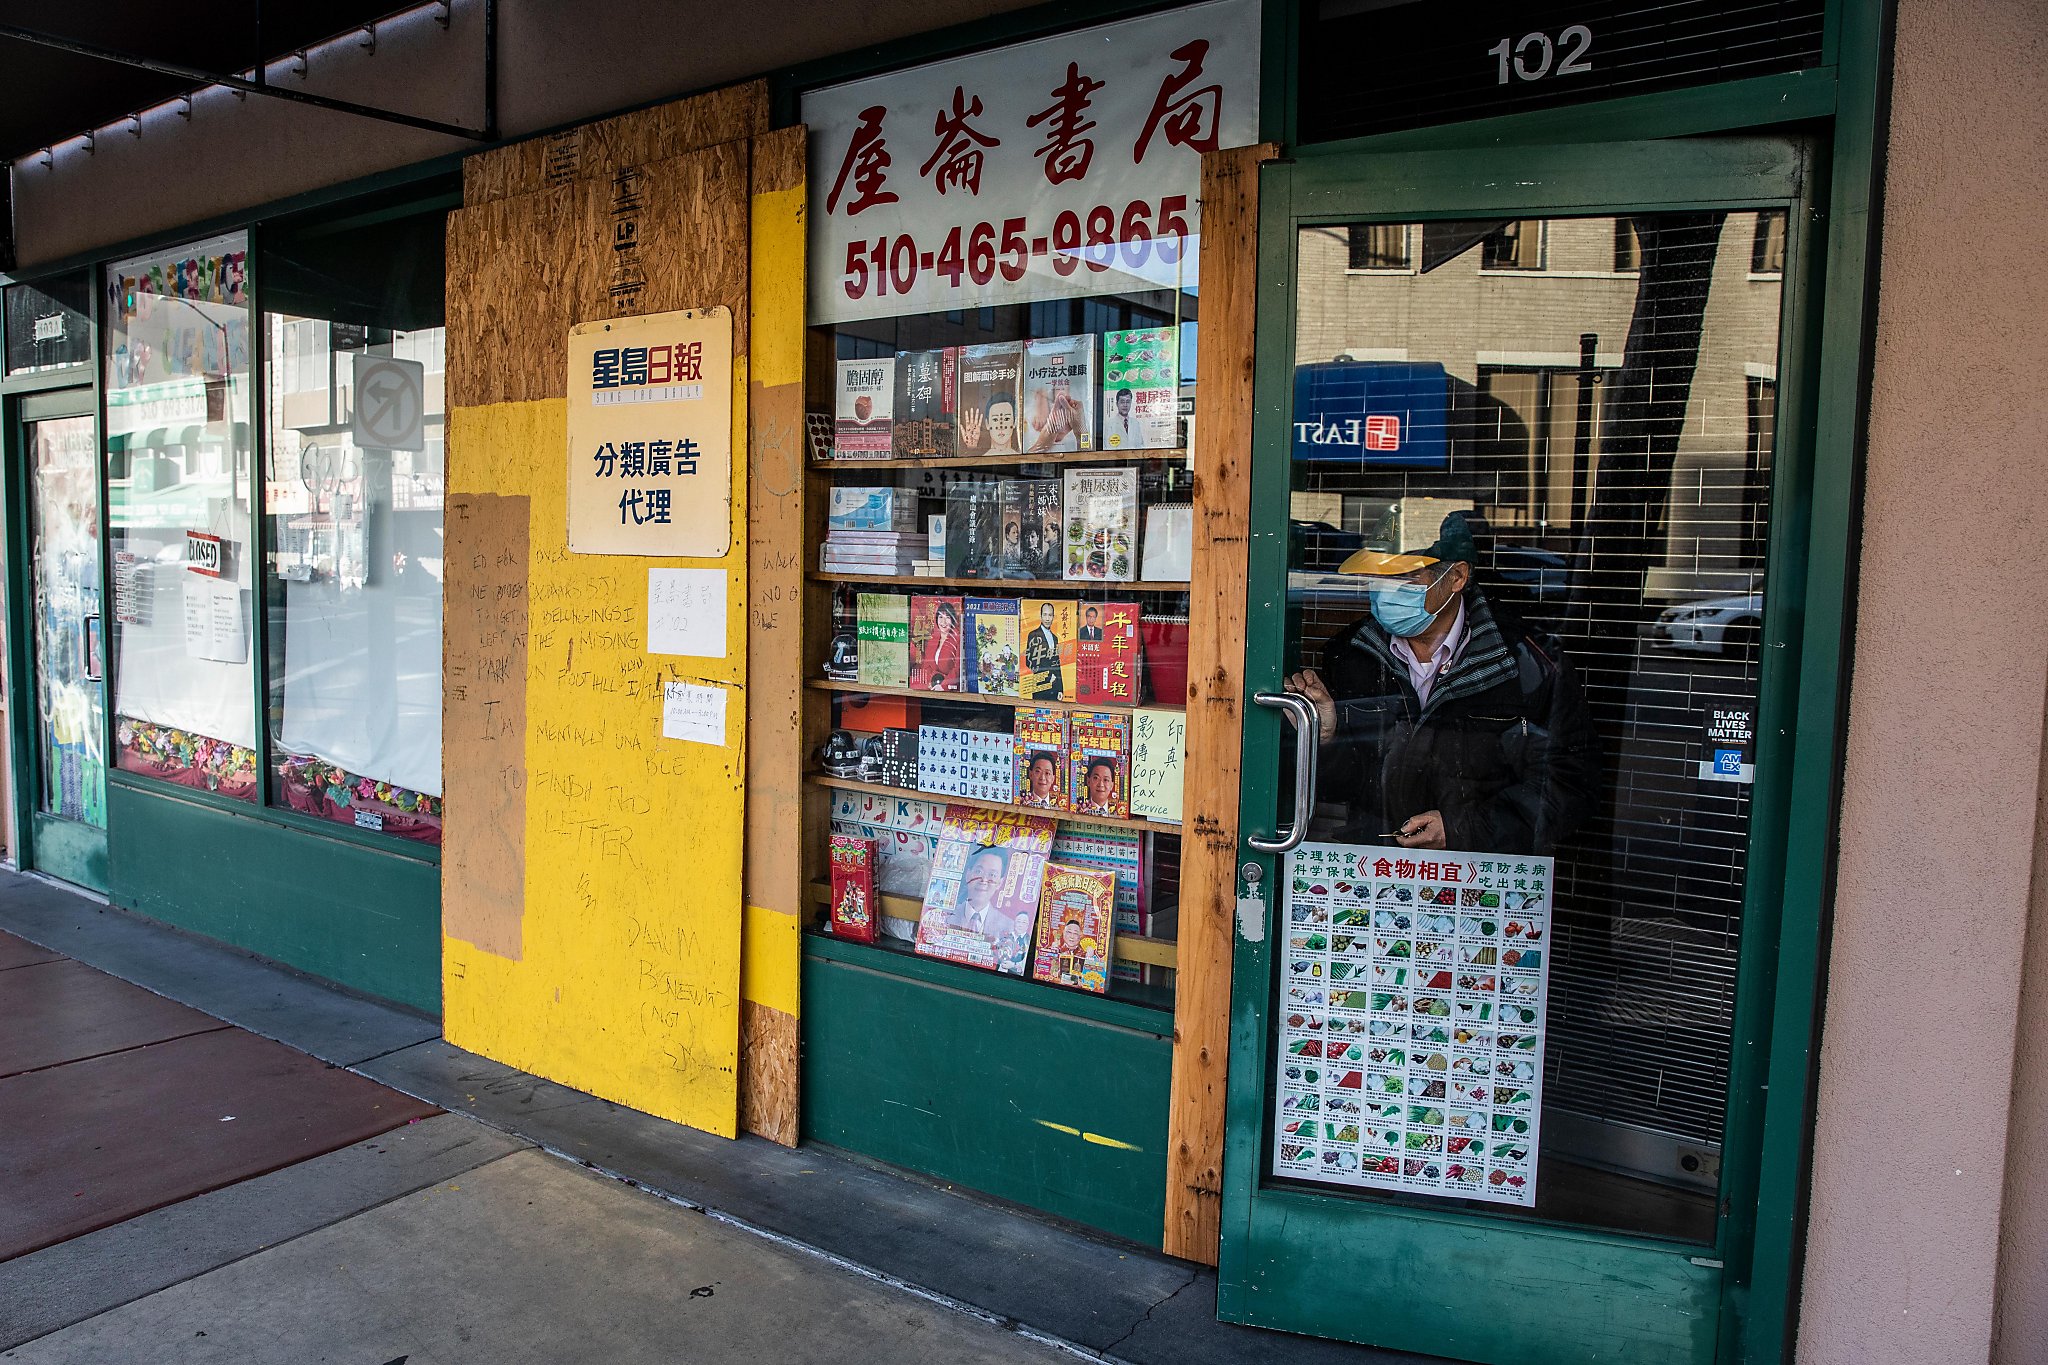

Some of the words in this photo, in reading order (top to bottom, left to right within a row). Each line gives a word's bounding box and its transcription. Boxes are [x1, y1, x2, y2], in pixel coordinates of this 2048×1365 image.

[1488, 25, 1592, 84] 102
[827, 38, 1222, 216] 屋崙書局
[616, 222, 634, 241] LP
[844, 195, 1188, 300] 510-465-9865
[593, 342, 702, 389] 星島日報
[1028, 364, 1088, 380] 小疗法大健康
[916, 361, 933, 404] 墓碑
[596, 391, 621, 403] SING
[593, 438, 701, 479] 分類廣告
[1080, 478, 1119, 494] 糖尿病
[618, 488, 672, 526] 代理
[189, 539, 217, 568] CLOSED
[1105, 611, 1133, 697] 牛年運程
[1713, 710, 1750, 721] BLACK
[1715, 719, 1746, 730] LIVES
[1707, 728, 1753, 740] MATTER
[1720, 753, 1742, 763] AM
[1722, 761, 1741, 771] EX
[1132, 764, 1165, 785] Copy
[1132, 785, 1155, 798] Fax
[864, 796, 873, 811] J
[898, 800, 909, 817] K
[1132, 800, 1168, 815] Service
[932, 806, 942, 822] L
[862, 825, 875, 838] N
[896, 831, 908, 844] O
[1293, 849, 1358, 864] 合理饮食
[1293, 864, 1357, 879] 科学保健
[1479, 860, 1547, 877] 预防疾病
[1478, 876, 1546, 892] 吃出健康
